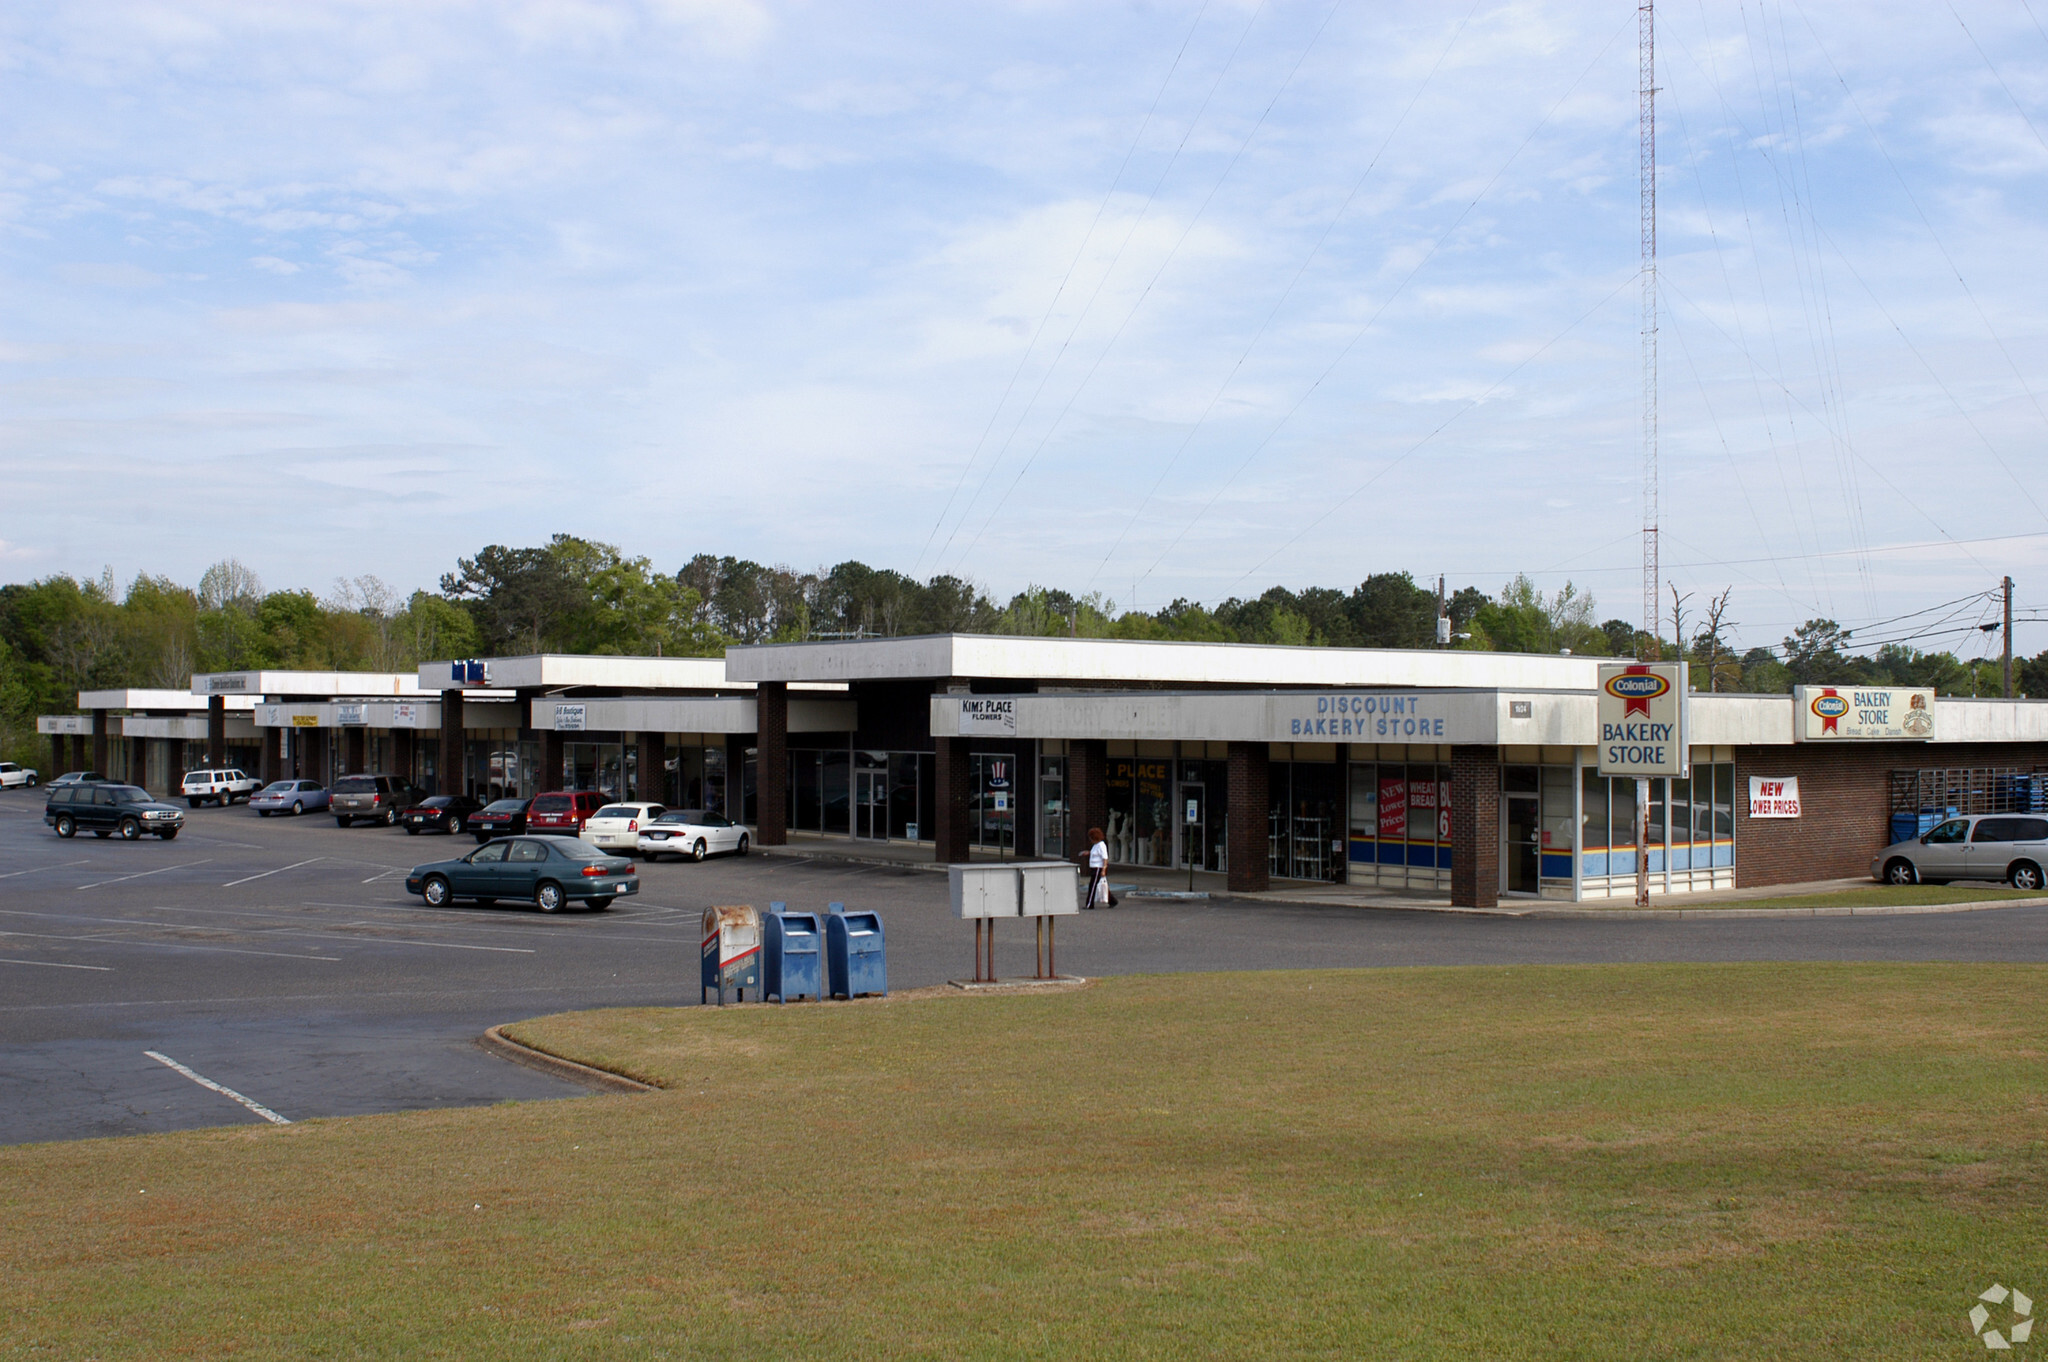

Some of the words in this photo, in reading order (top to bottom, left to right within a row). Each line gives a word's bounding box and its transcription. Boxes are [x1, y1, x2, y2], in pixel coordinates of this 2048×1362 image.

[1616, 680, 1658, 692] Colonial
[963, 699, 984, 713] KIMS
[986, 700, 1012, 713] PLACE
[1317, 697, 1418, 714] DISCOUNT
[1819, 701, 1844, 711] Colonial
[1854, 692, 1891, 707] BAKERY
[1858, 709, 1889, 725] STORE
[1291, 718, 1365, 735] BAKERY
[1376, 718, 1444, 736] STORE
[1603, 723, 1674, 741] BAKERY
[1608, 745, 1666, 764] STORE
[1117, 764, 1166, 778] PLACE
[1381, 783, 1405, 800] NEW
[1409, 782, 1436, 793] WHEAT
[1760, 782, 1784, 796] NEW
[1410, 795, 1436, 807] BREAD
[1773, 800, 1798, 814] PRICES
